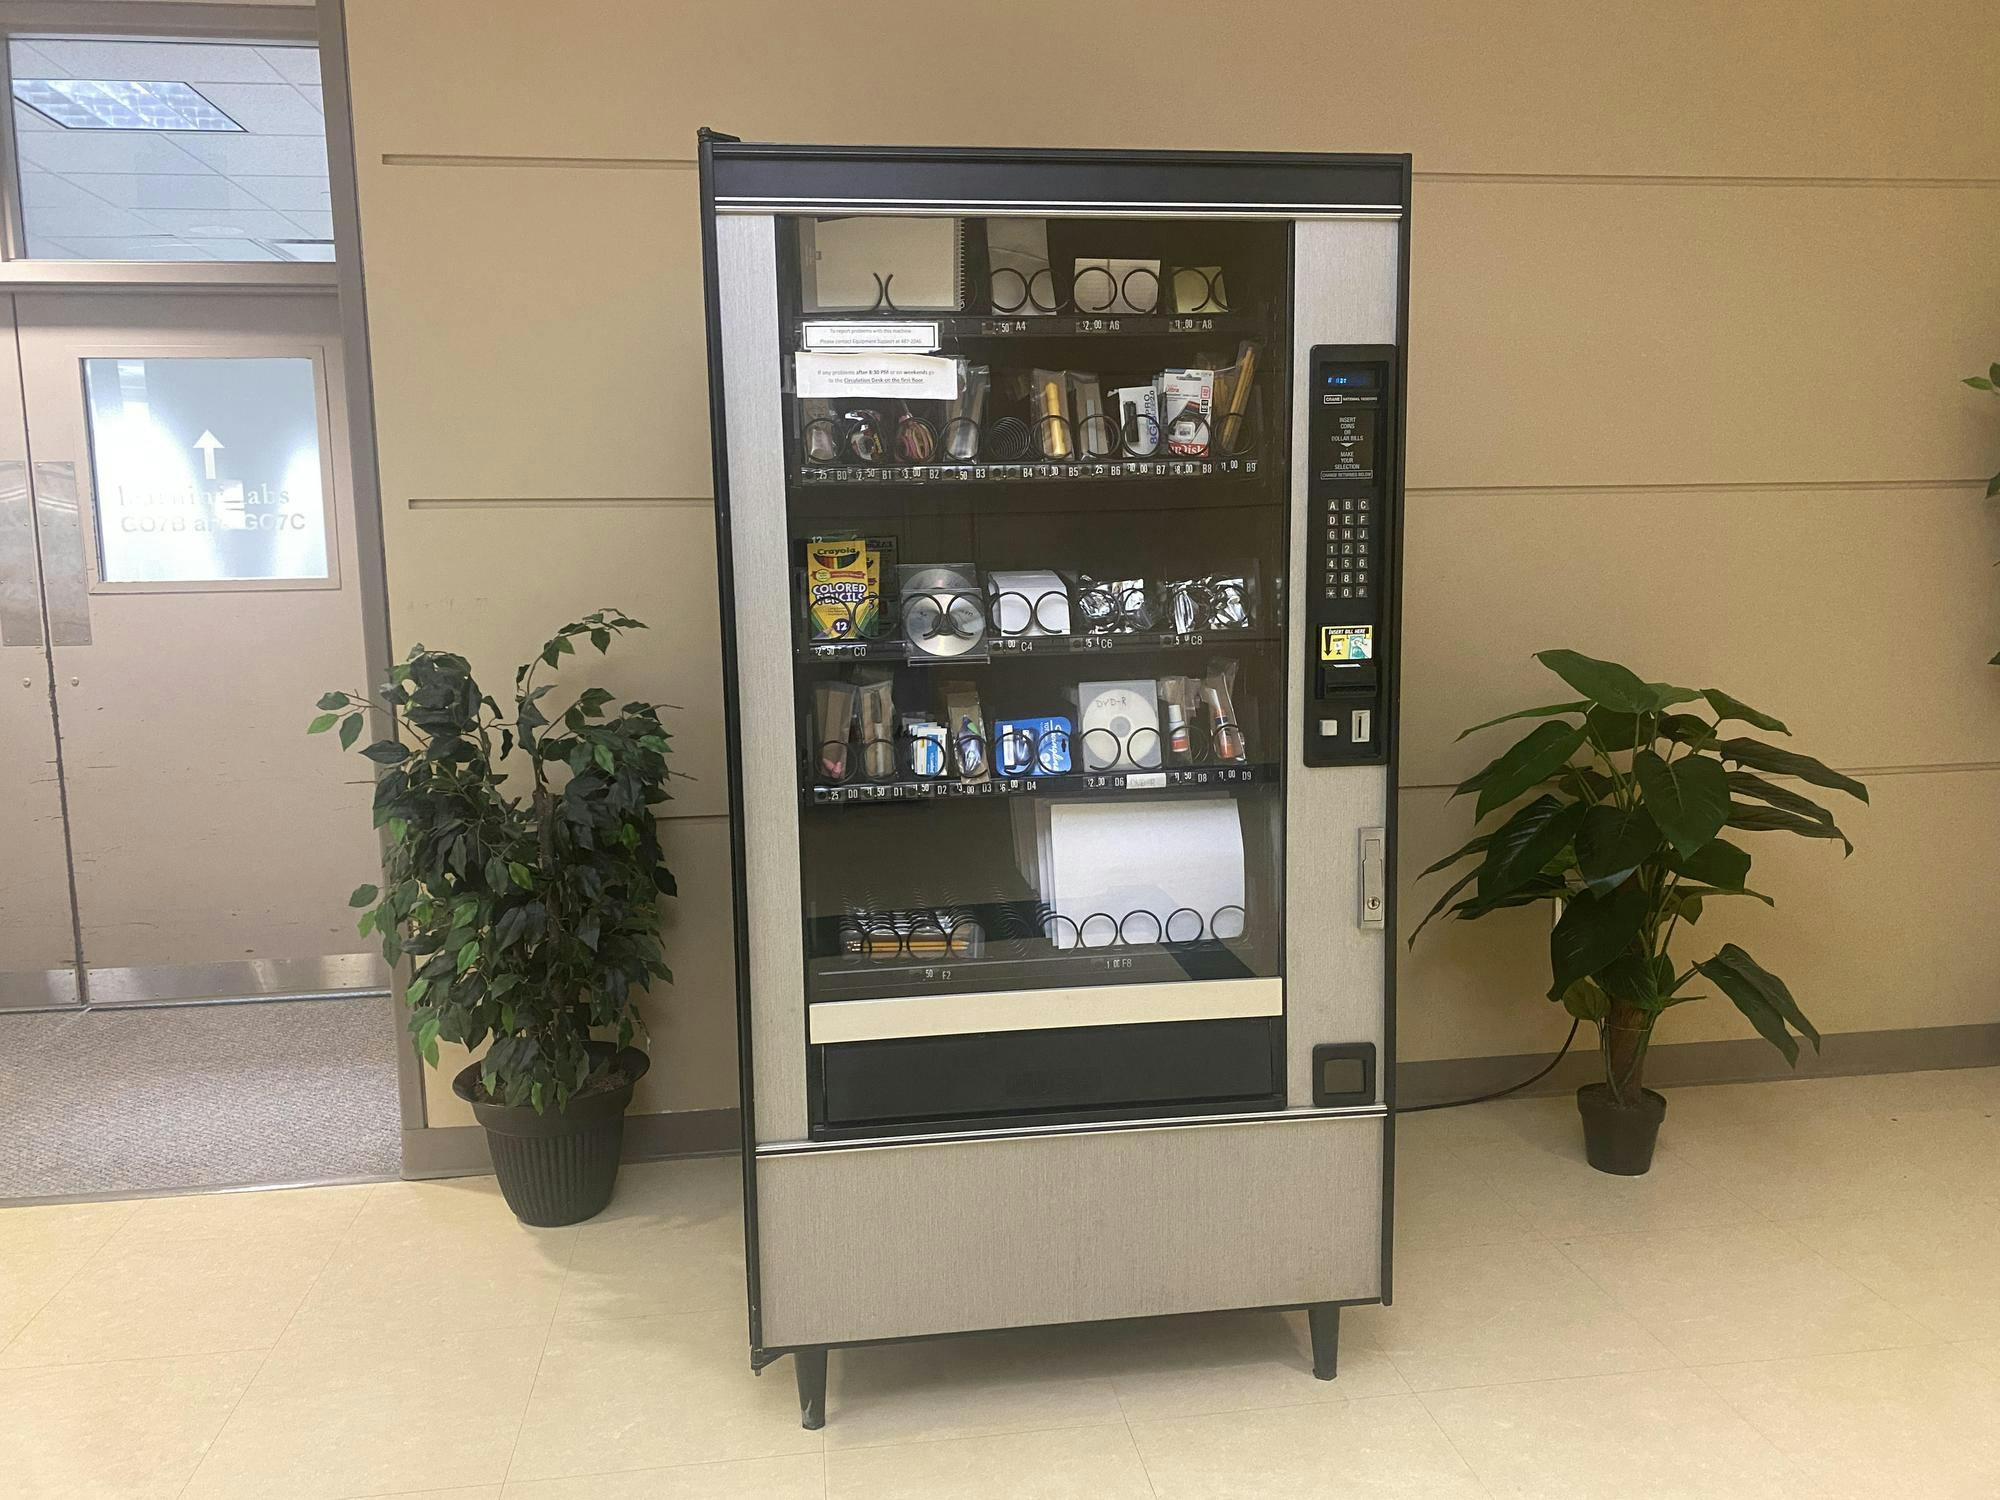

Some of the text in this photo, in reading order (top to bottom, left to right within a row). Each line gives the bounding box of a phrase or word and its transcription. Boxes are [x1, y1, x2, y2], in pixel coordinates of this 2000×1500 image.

[1015, 321, 1026, 331] A4
[1109, 319, 1120, 330] A6
[1202, 319, 1212, 329] A8
[1068, 467, 1079, 477] B5
[1111, 465, 1121, 476] B6
[1156, 464, 1166, 475] B7
[1202, 463, 1212, 474] B8
[1246, 462, 1257, 472] B9
[882, 469, 892, 480] B1
[929, 469, 939, 479] B2
[975, 468, 986, 479] B3
[1023, 467, 1033, 478] B4
[1329, 500, 1366, 510] A B C
[1330, 515, 1365, 525] D E F
[1329, 530, 1365, 539] G H J
[817, 546, 857, 556] Crayola
[1344, 545, 1350, 553] 2
[1359, 544, 1365, 553] 3
[1328, 559, 1365, 568] 4 5 6
[1328, 574, 1364, 583] 7 8 9
[813, 583, 867, 595] COLORED
[1343, 589, 1349, 597] 0
[816, 593, 865, 605] PENCILS
[835, 621, 848, 631] 12
[1101, 638, 1113, 649] C6
[1191, 635, 1203, 646] C8
[1021, 641, 1033, 652] C4
[1095, 696, 1127, 708] DVD-R
[1198, 773, 1208, 783] D8
[1242, 771, 1252, 780] D9
[1026, 781, 1037, 791] D4
[1114, 776, 1124, 787] D6
[893, 786, 903, 796] D1
[937, 785, 948, 795] D2
[982, 783, 992, 792] D3
[1122, 958, 1132, 968] F8
[942, 970, 952, 980] F2
